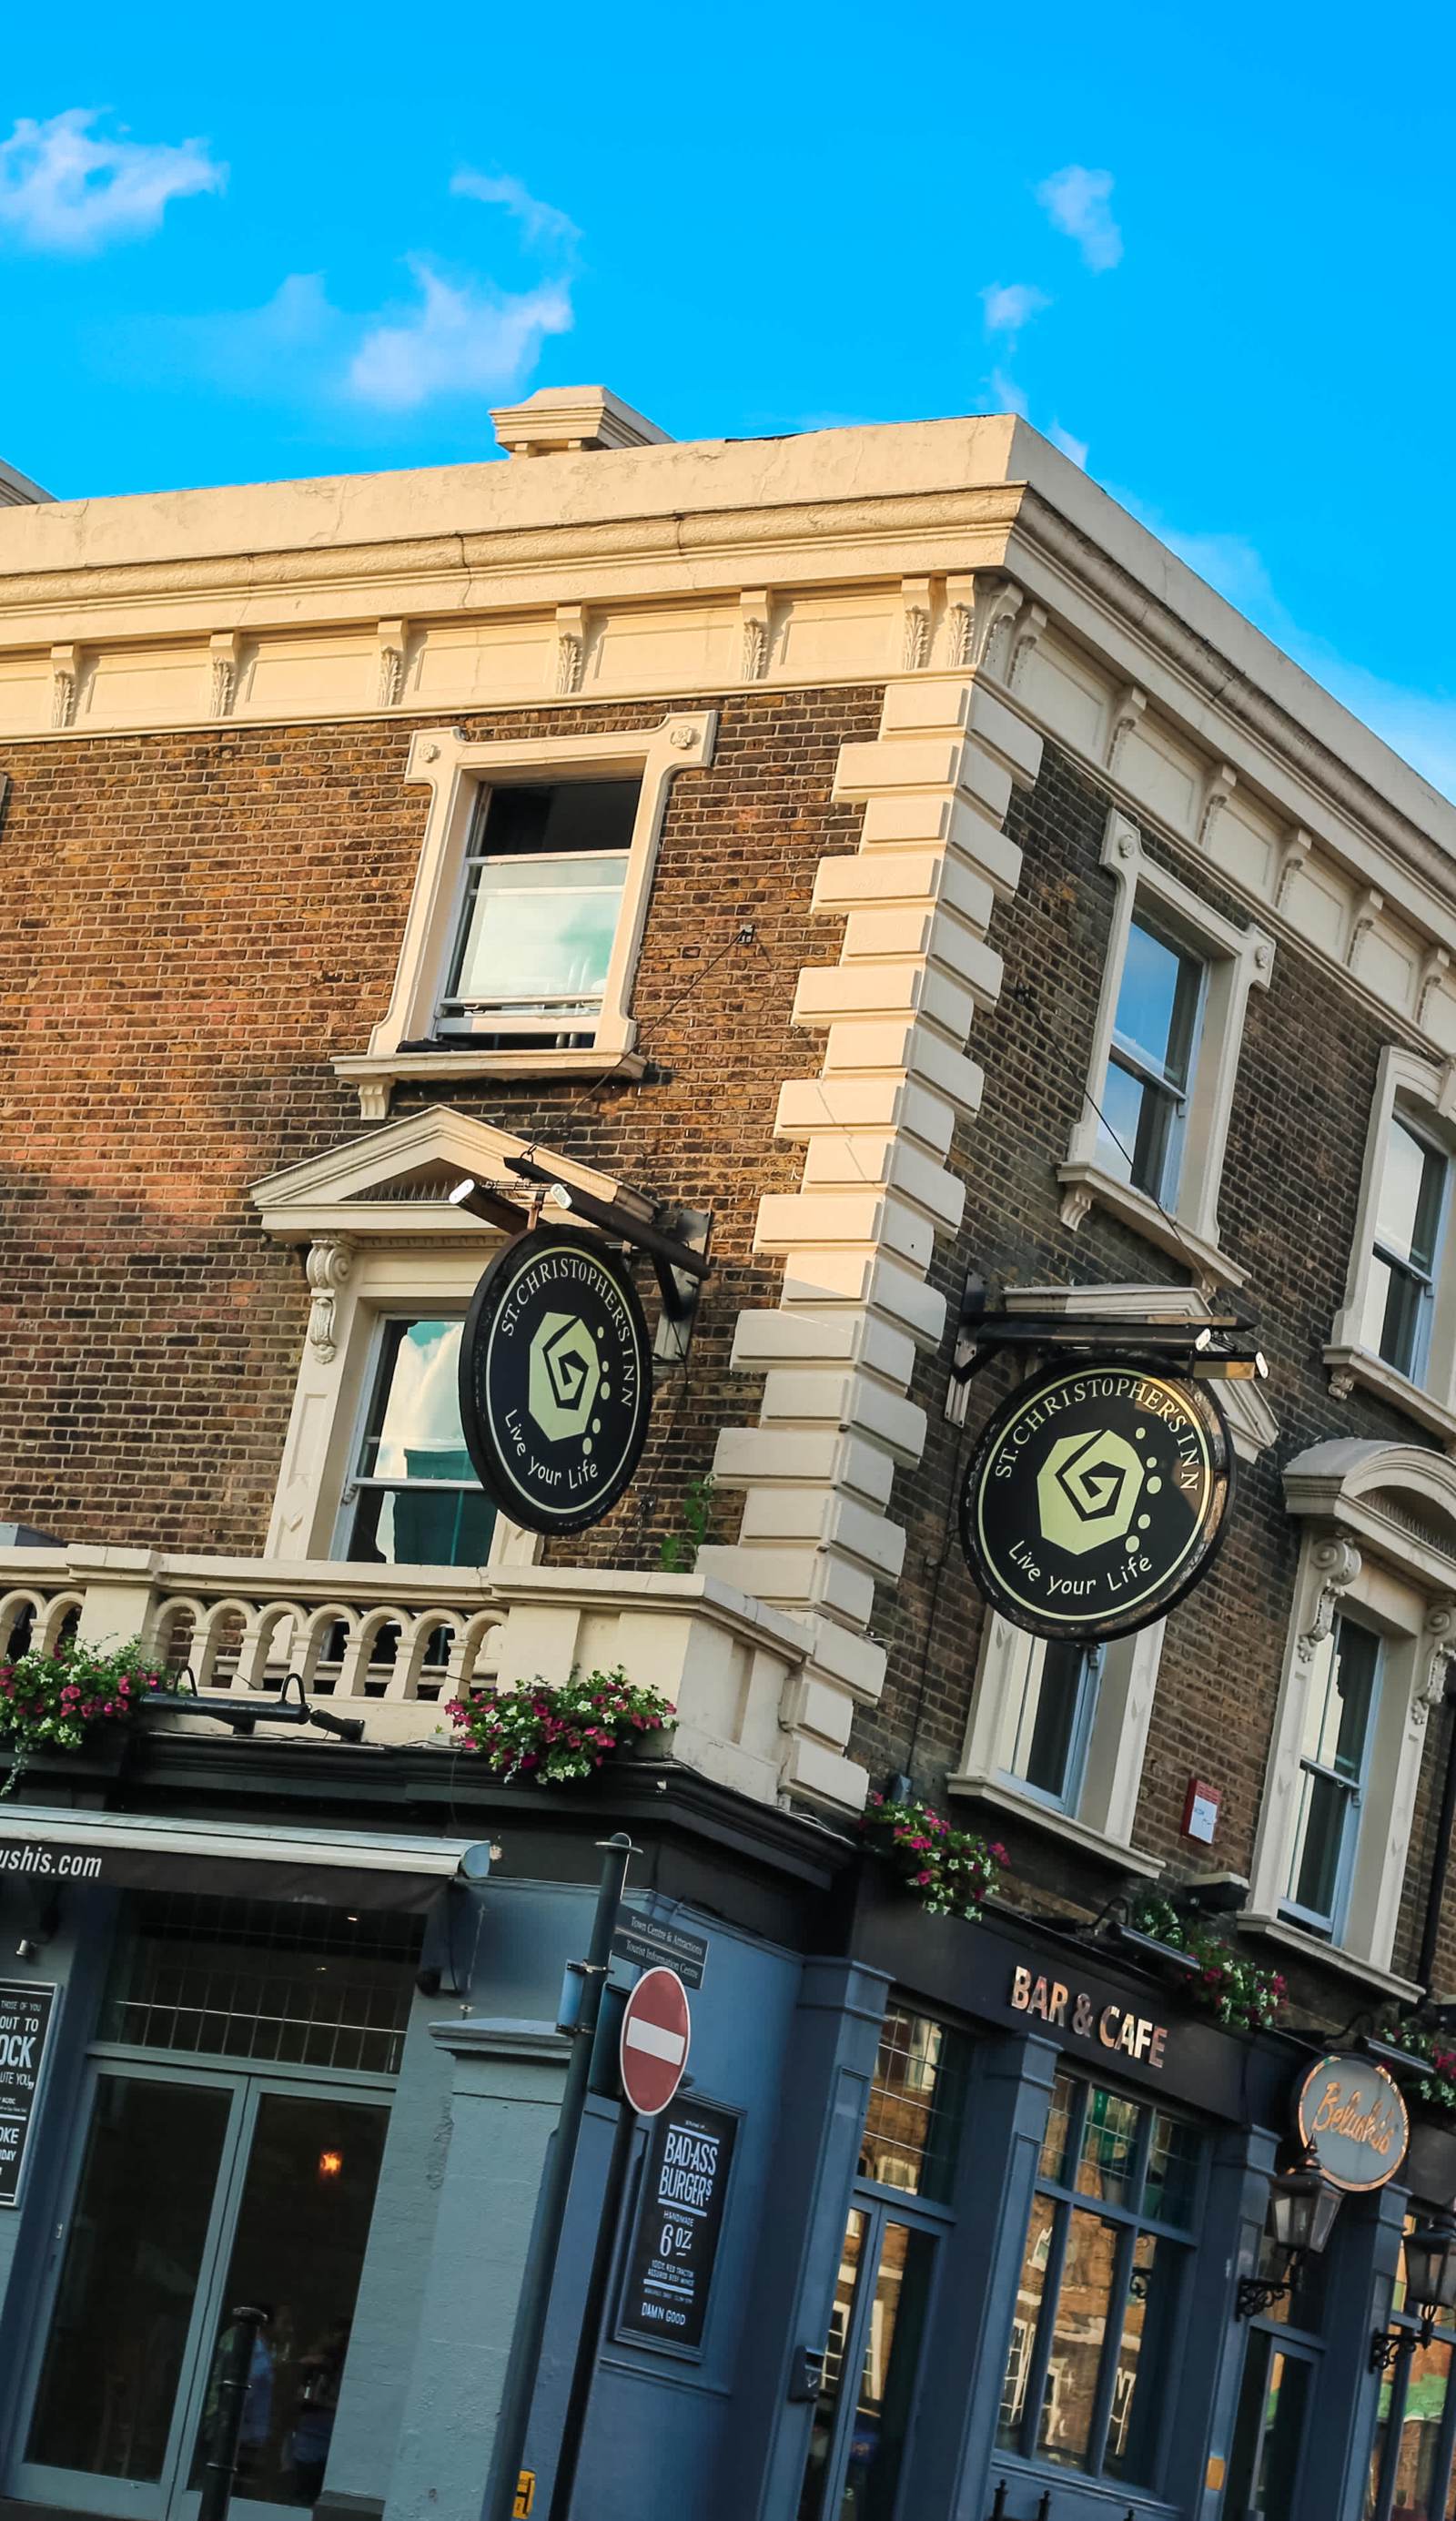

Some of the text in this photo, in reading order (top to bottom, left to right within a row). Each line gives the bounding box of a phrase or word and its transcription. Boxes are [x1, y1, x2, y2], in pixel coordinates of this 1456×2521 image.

[621, 1348, 635, 1408] INN
[504, 1409, 599, 1490] Live your Life
[1177, 1432, 1200, 1491] INN
[1008, 1540, 1153, 1596] Live your Life
[631, 1915, 647, 1932] Town
[647, 1923, 666, 1940] Centre
[626, 1939, 699, 1979] Tourist Information Centre
[25, 2017, 39, 2032] TO
[1011, 1965, 1169, 2069] BAR & CAFE
[658, 2164, 713, 2207] BURGERS
[660, 2223, 673, 2257] 6
[642, 2302, 686, 2326] DAMN GOOD
